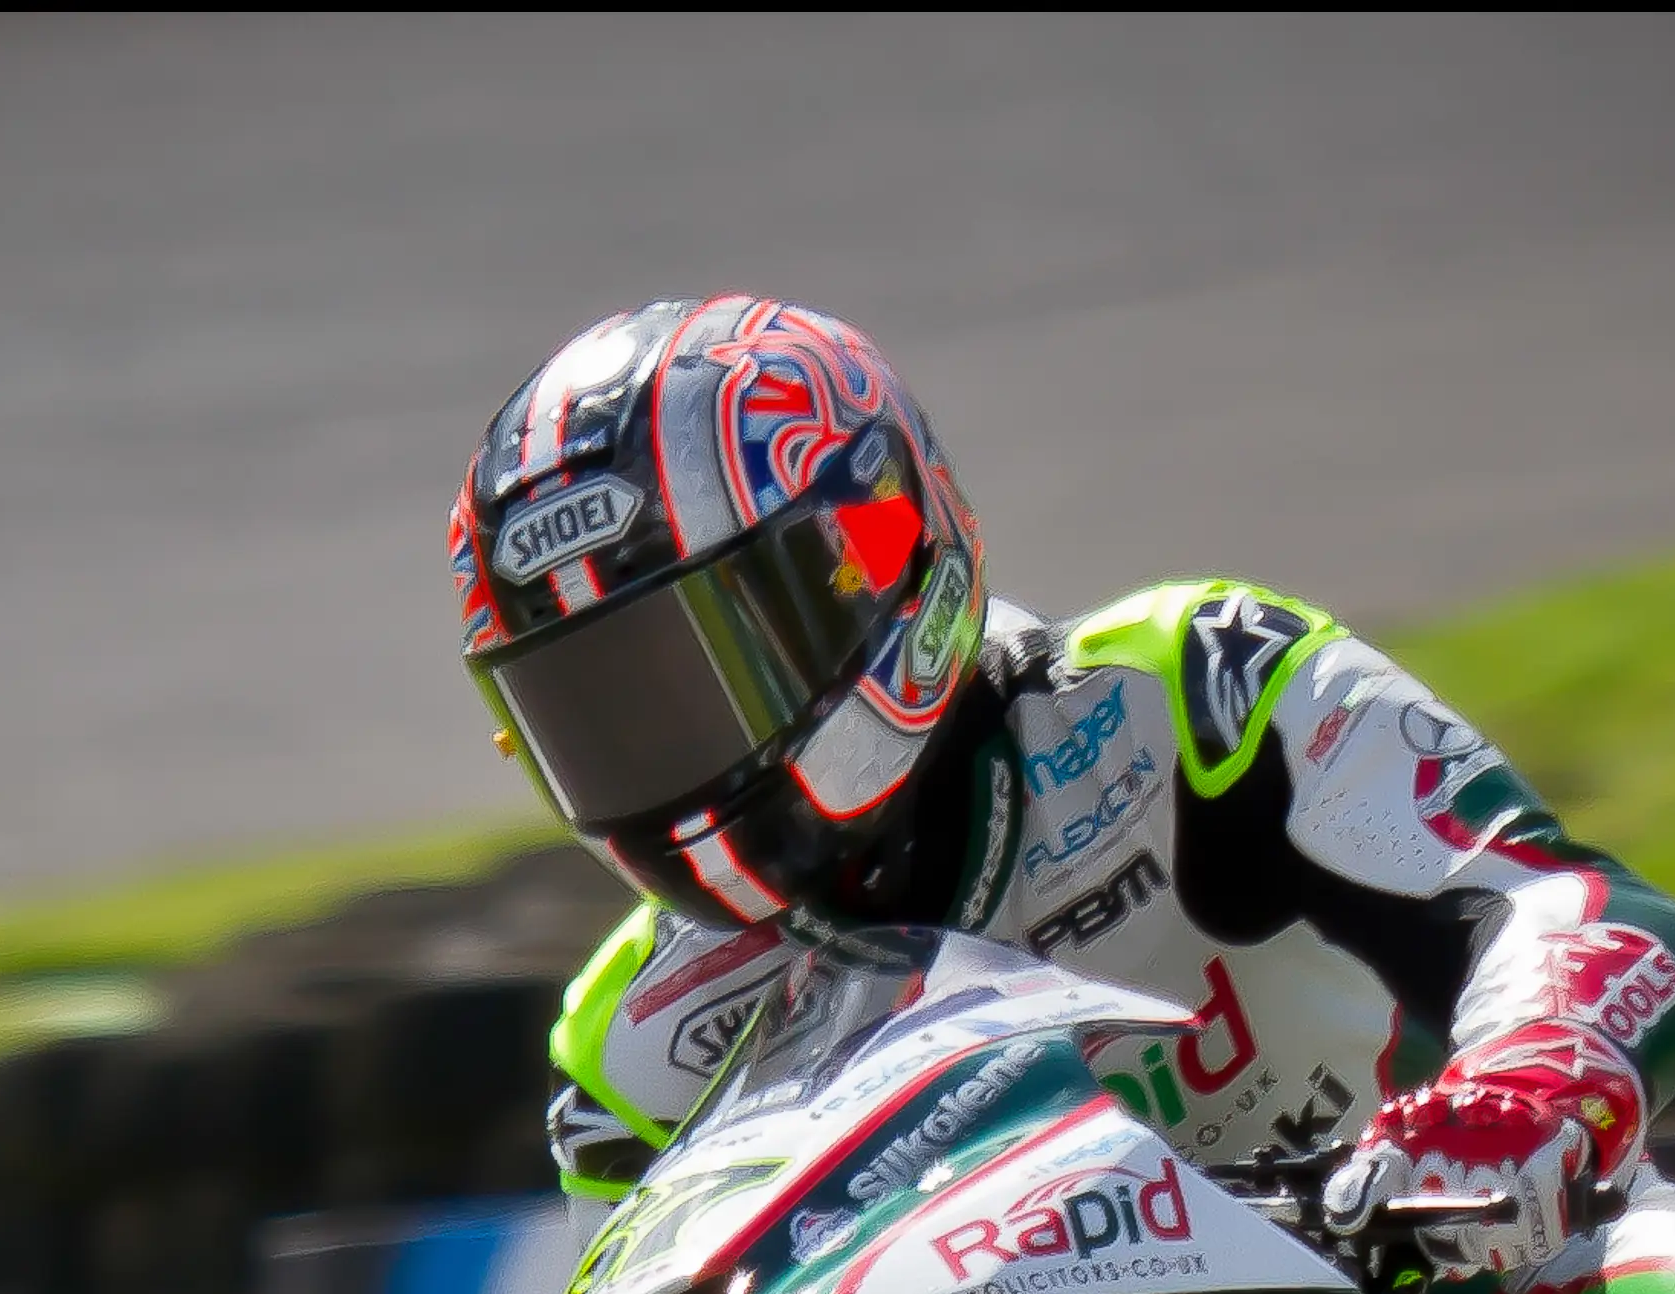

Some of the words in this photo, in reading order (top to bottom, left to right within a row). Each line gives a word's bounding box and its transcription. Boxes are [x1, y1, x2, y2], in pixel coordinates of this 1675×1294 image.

[509, 490, 618, 568] SHOEI
[1023, 852, 1171, 956] PBM
[929, 1156, 1194, 1283] Rapid
